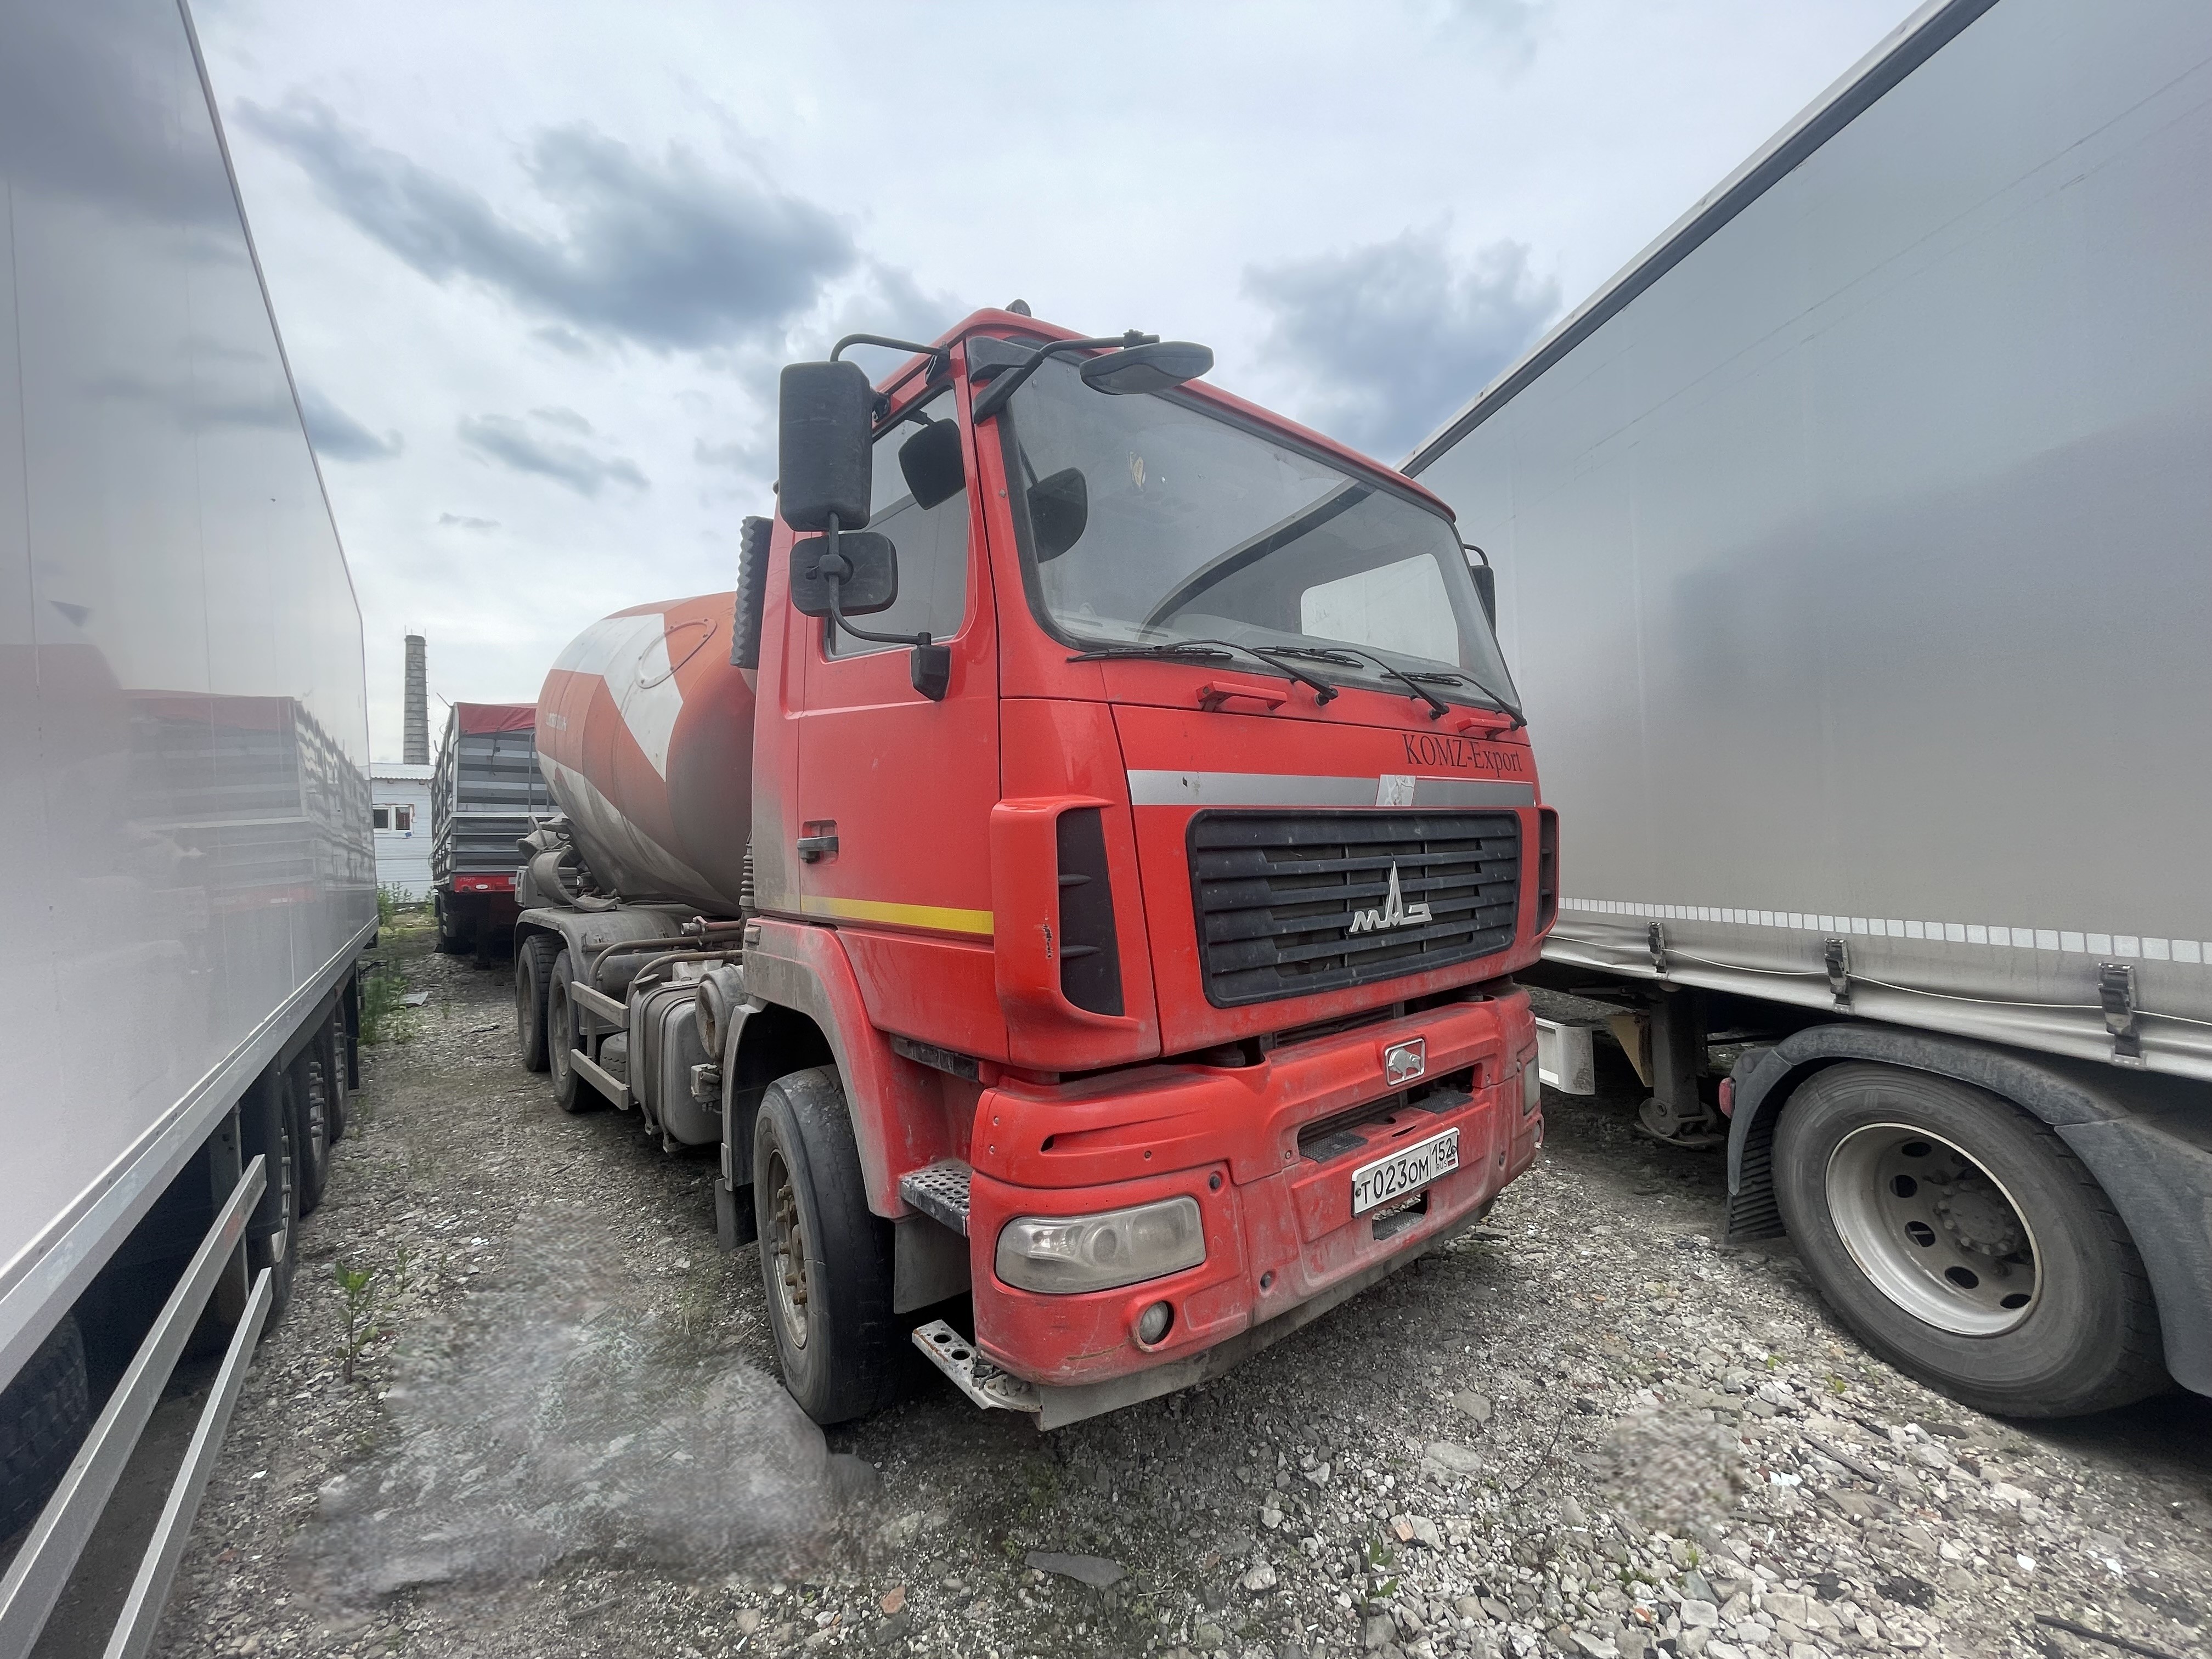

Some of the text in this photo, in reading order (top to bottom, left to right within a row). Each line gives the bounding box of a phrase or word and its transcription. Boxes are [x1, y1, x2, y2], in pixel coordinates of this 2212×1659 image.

[1401, 733, 1523, 778] KOMZ-Export
[1431, 1137, 1453, 1165] 152
[1436, 1160, 1447, 1171] RUS
